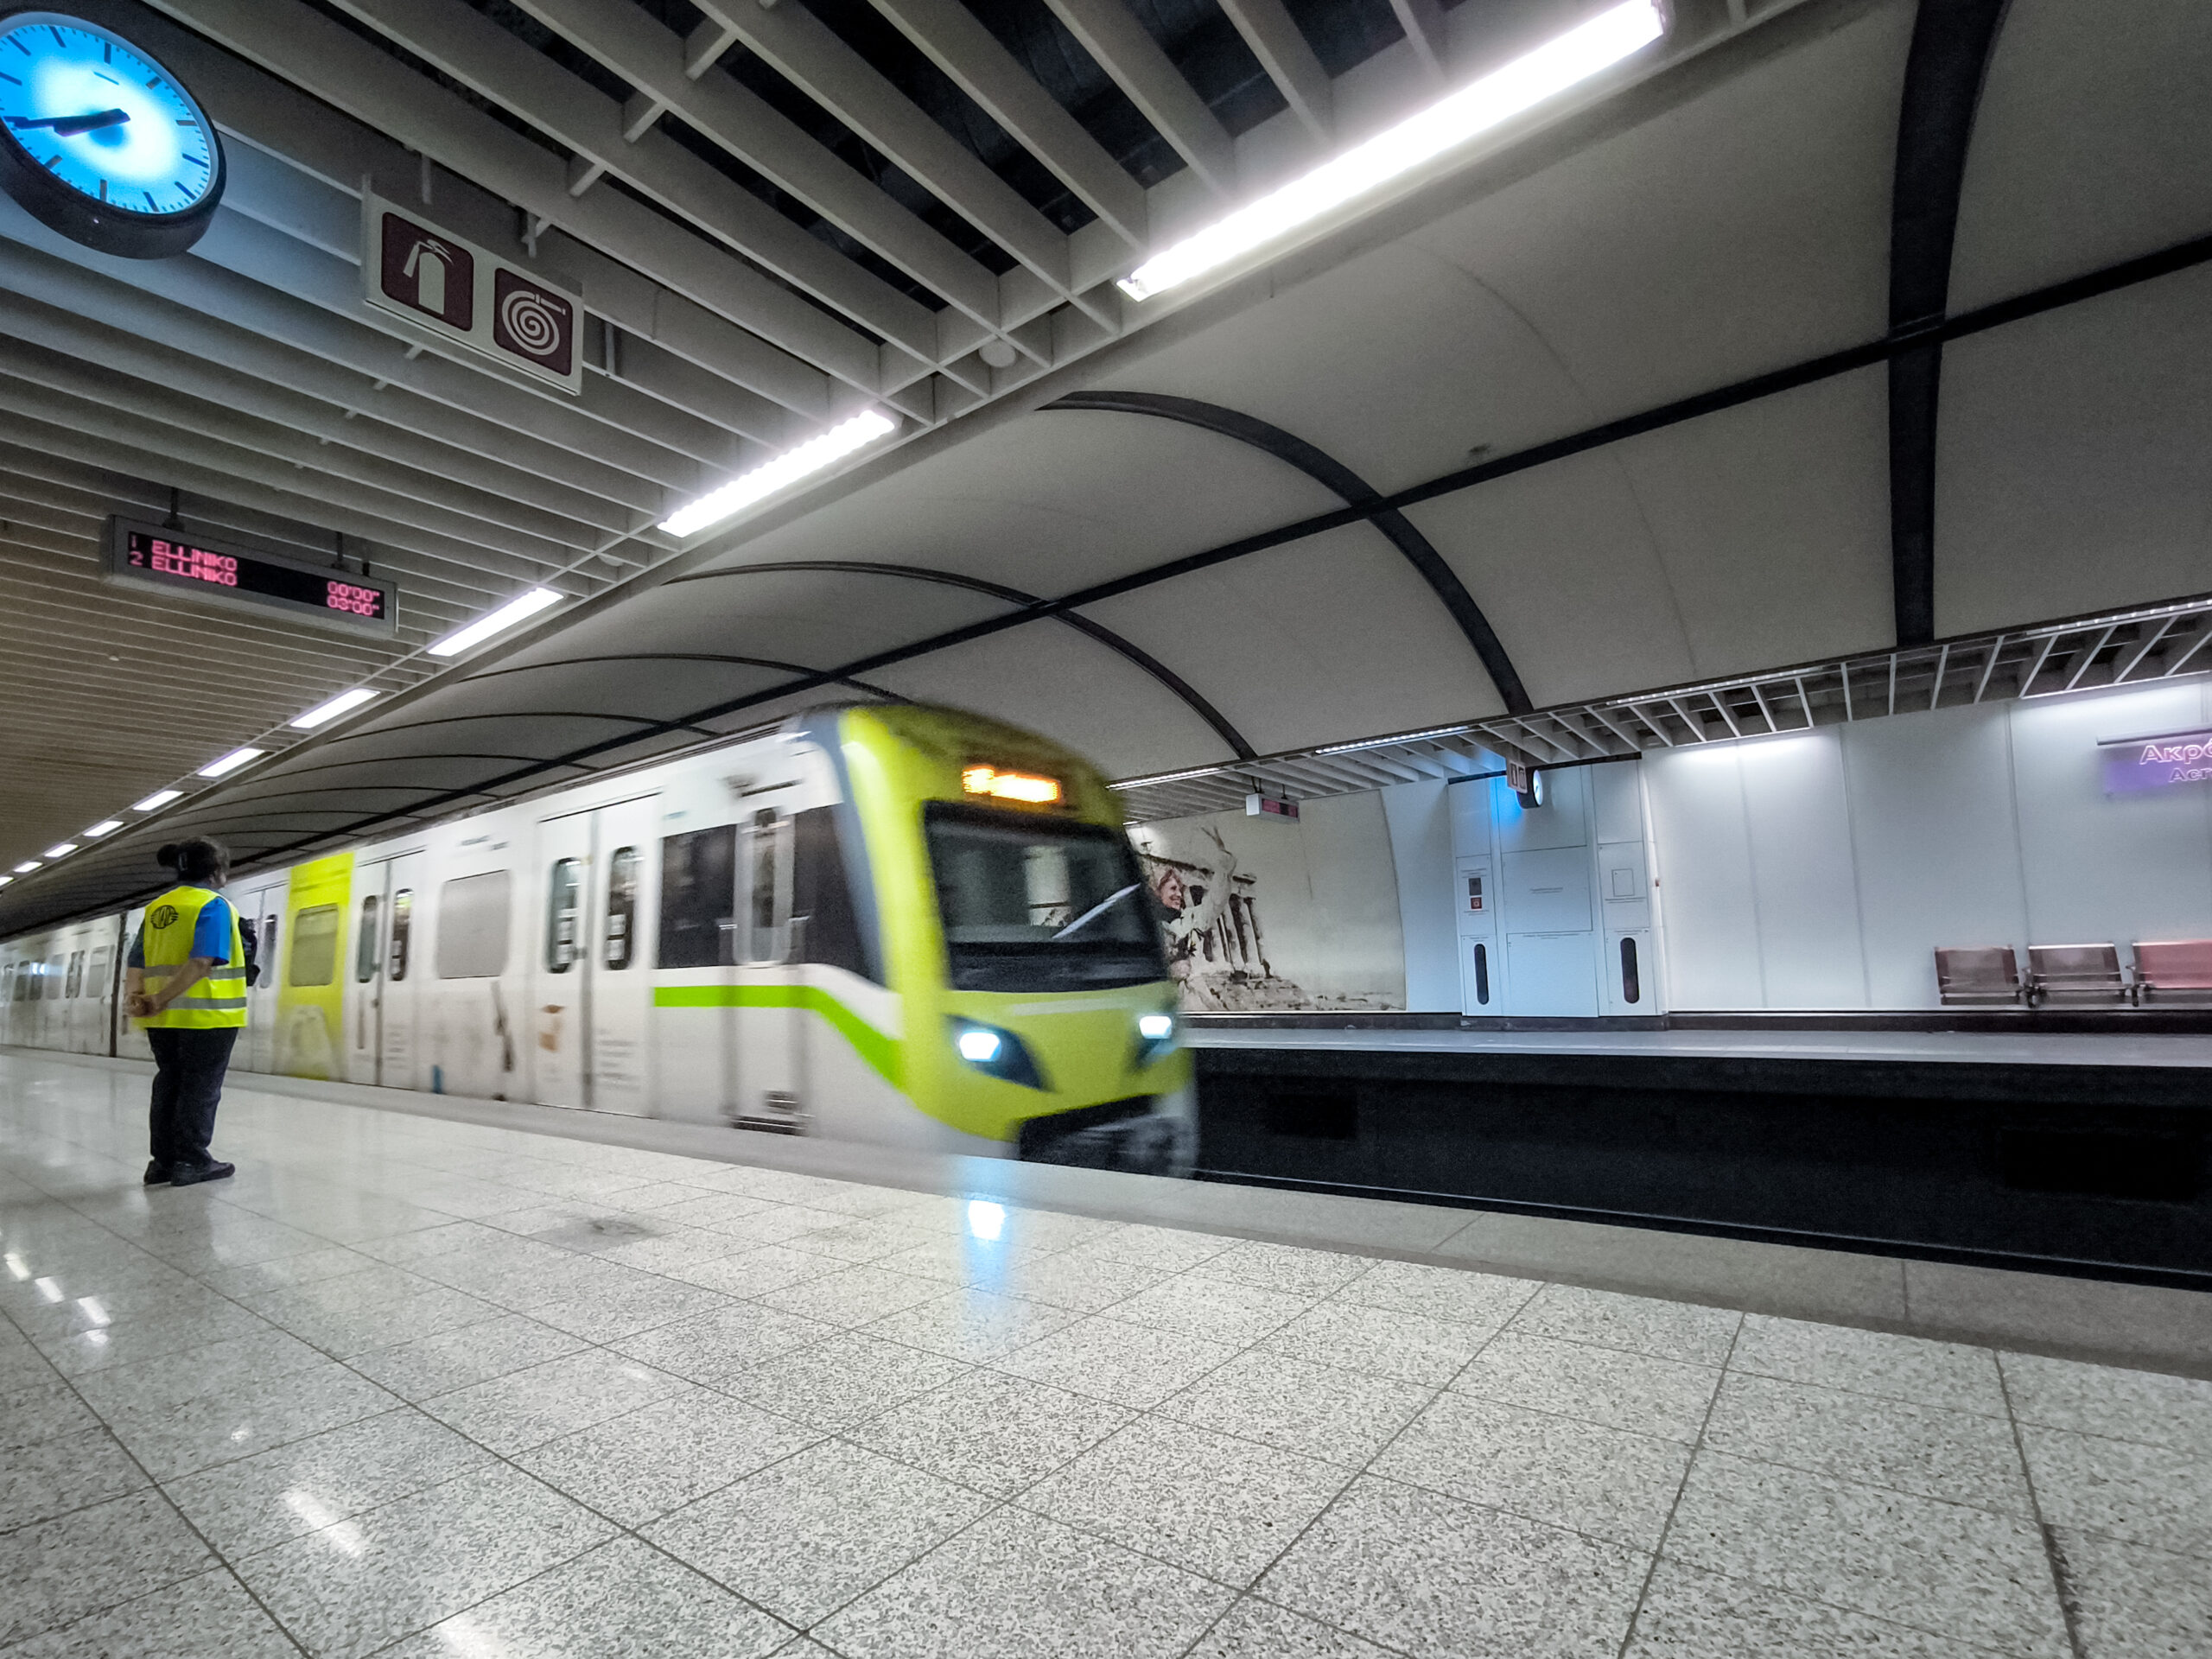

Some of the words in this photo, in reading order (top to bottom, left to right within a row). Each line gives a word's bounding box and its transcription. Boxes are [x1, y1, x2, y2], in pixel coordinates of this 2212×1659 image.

[129, 550, 144, 567] 2
[151, 554, 238, 587] ELLINIKO
[131, 535, 137, 549] 1
[151, 539, 238, 571] ELLINIKO
